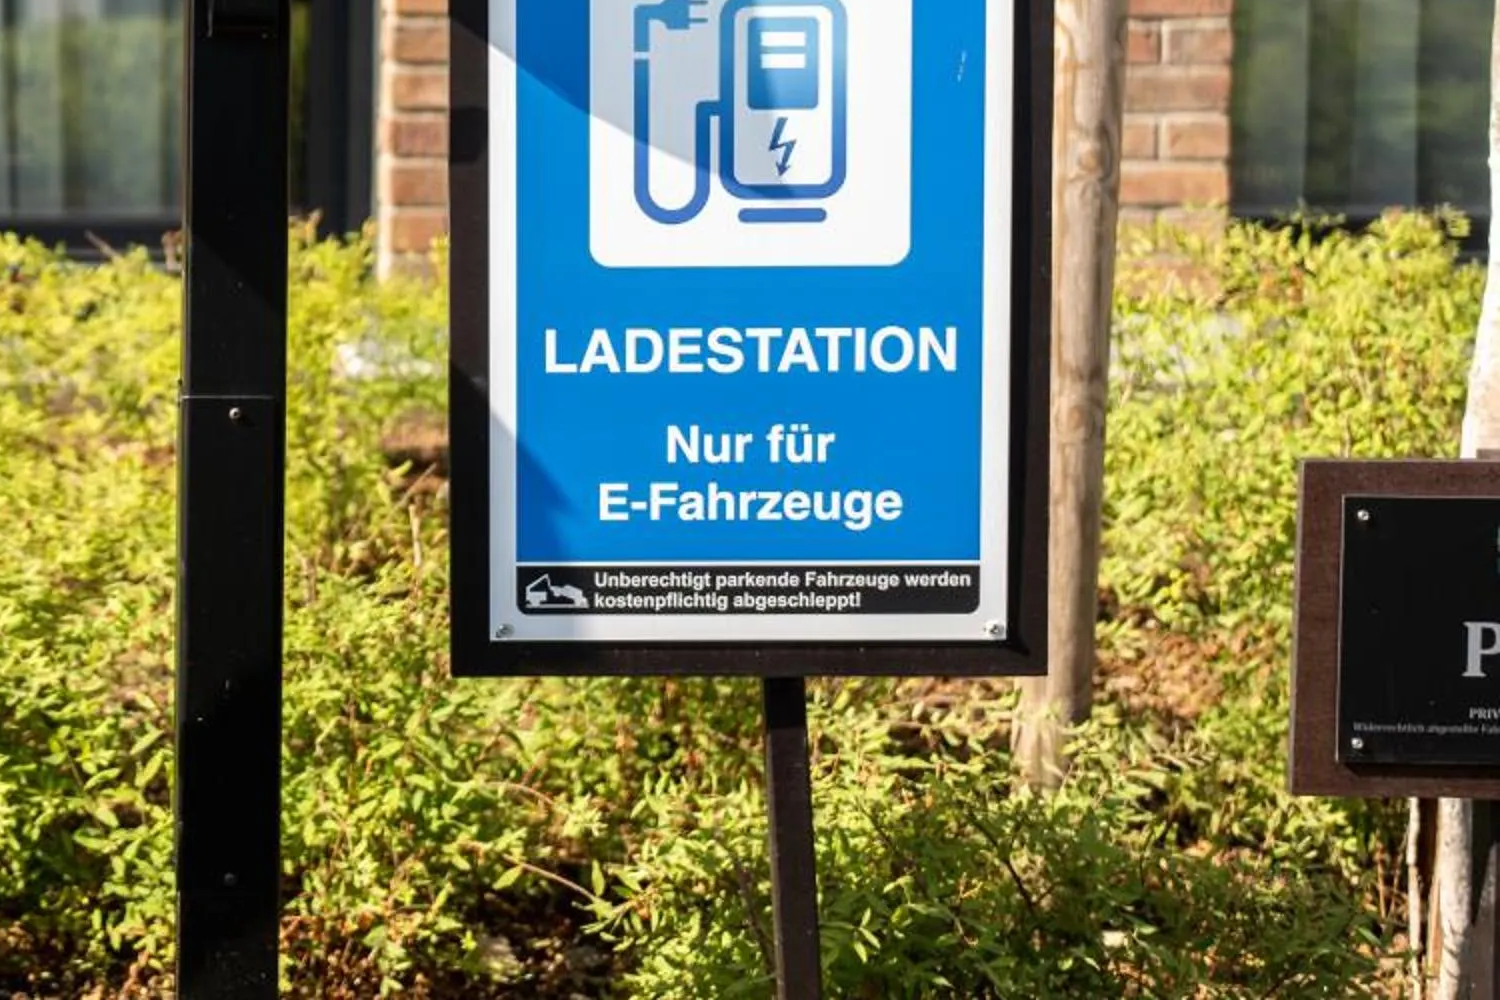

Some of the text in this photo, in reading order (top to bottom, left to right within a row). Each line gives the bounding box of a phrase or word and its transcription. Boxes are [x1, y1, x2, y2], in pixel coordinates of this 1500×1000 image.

[545, 325, 957, 374] LADESTATION
[666, 424, 836, 464] Nur für
[599, 481, 903, 531] E-Fahrzeuge
[594, 571, 971, 590] Unberechtigt parkende Fahrzeuge werden
[594, 592, 861, 611] kostenpflichtig abgeschleppt!
